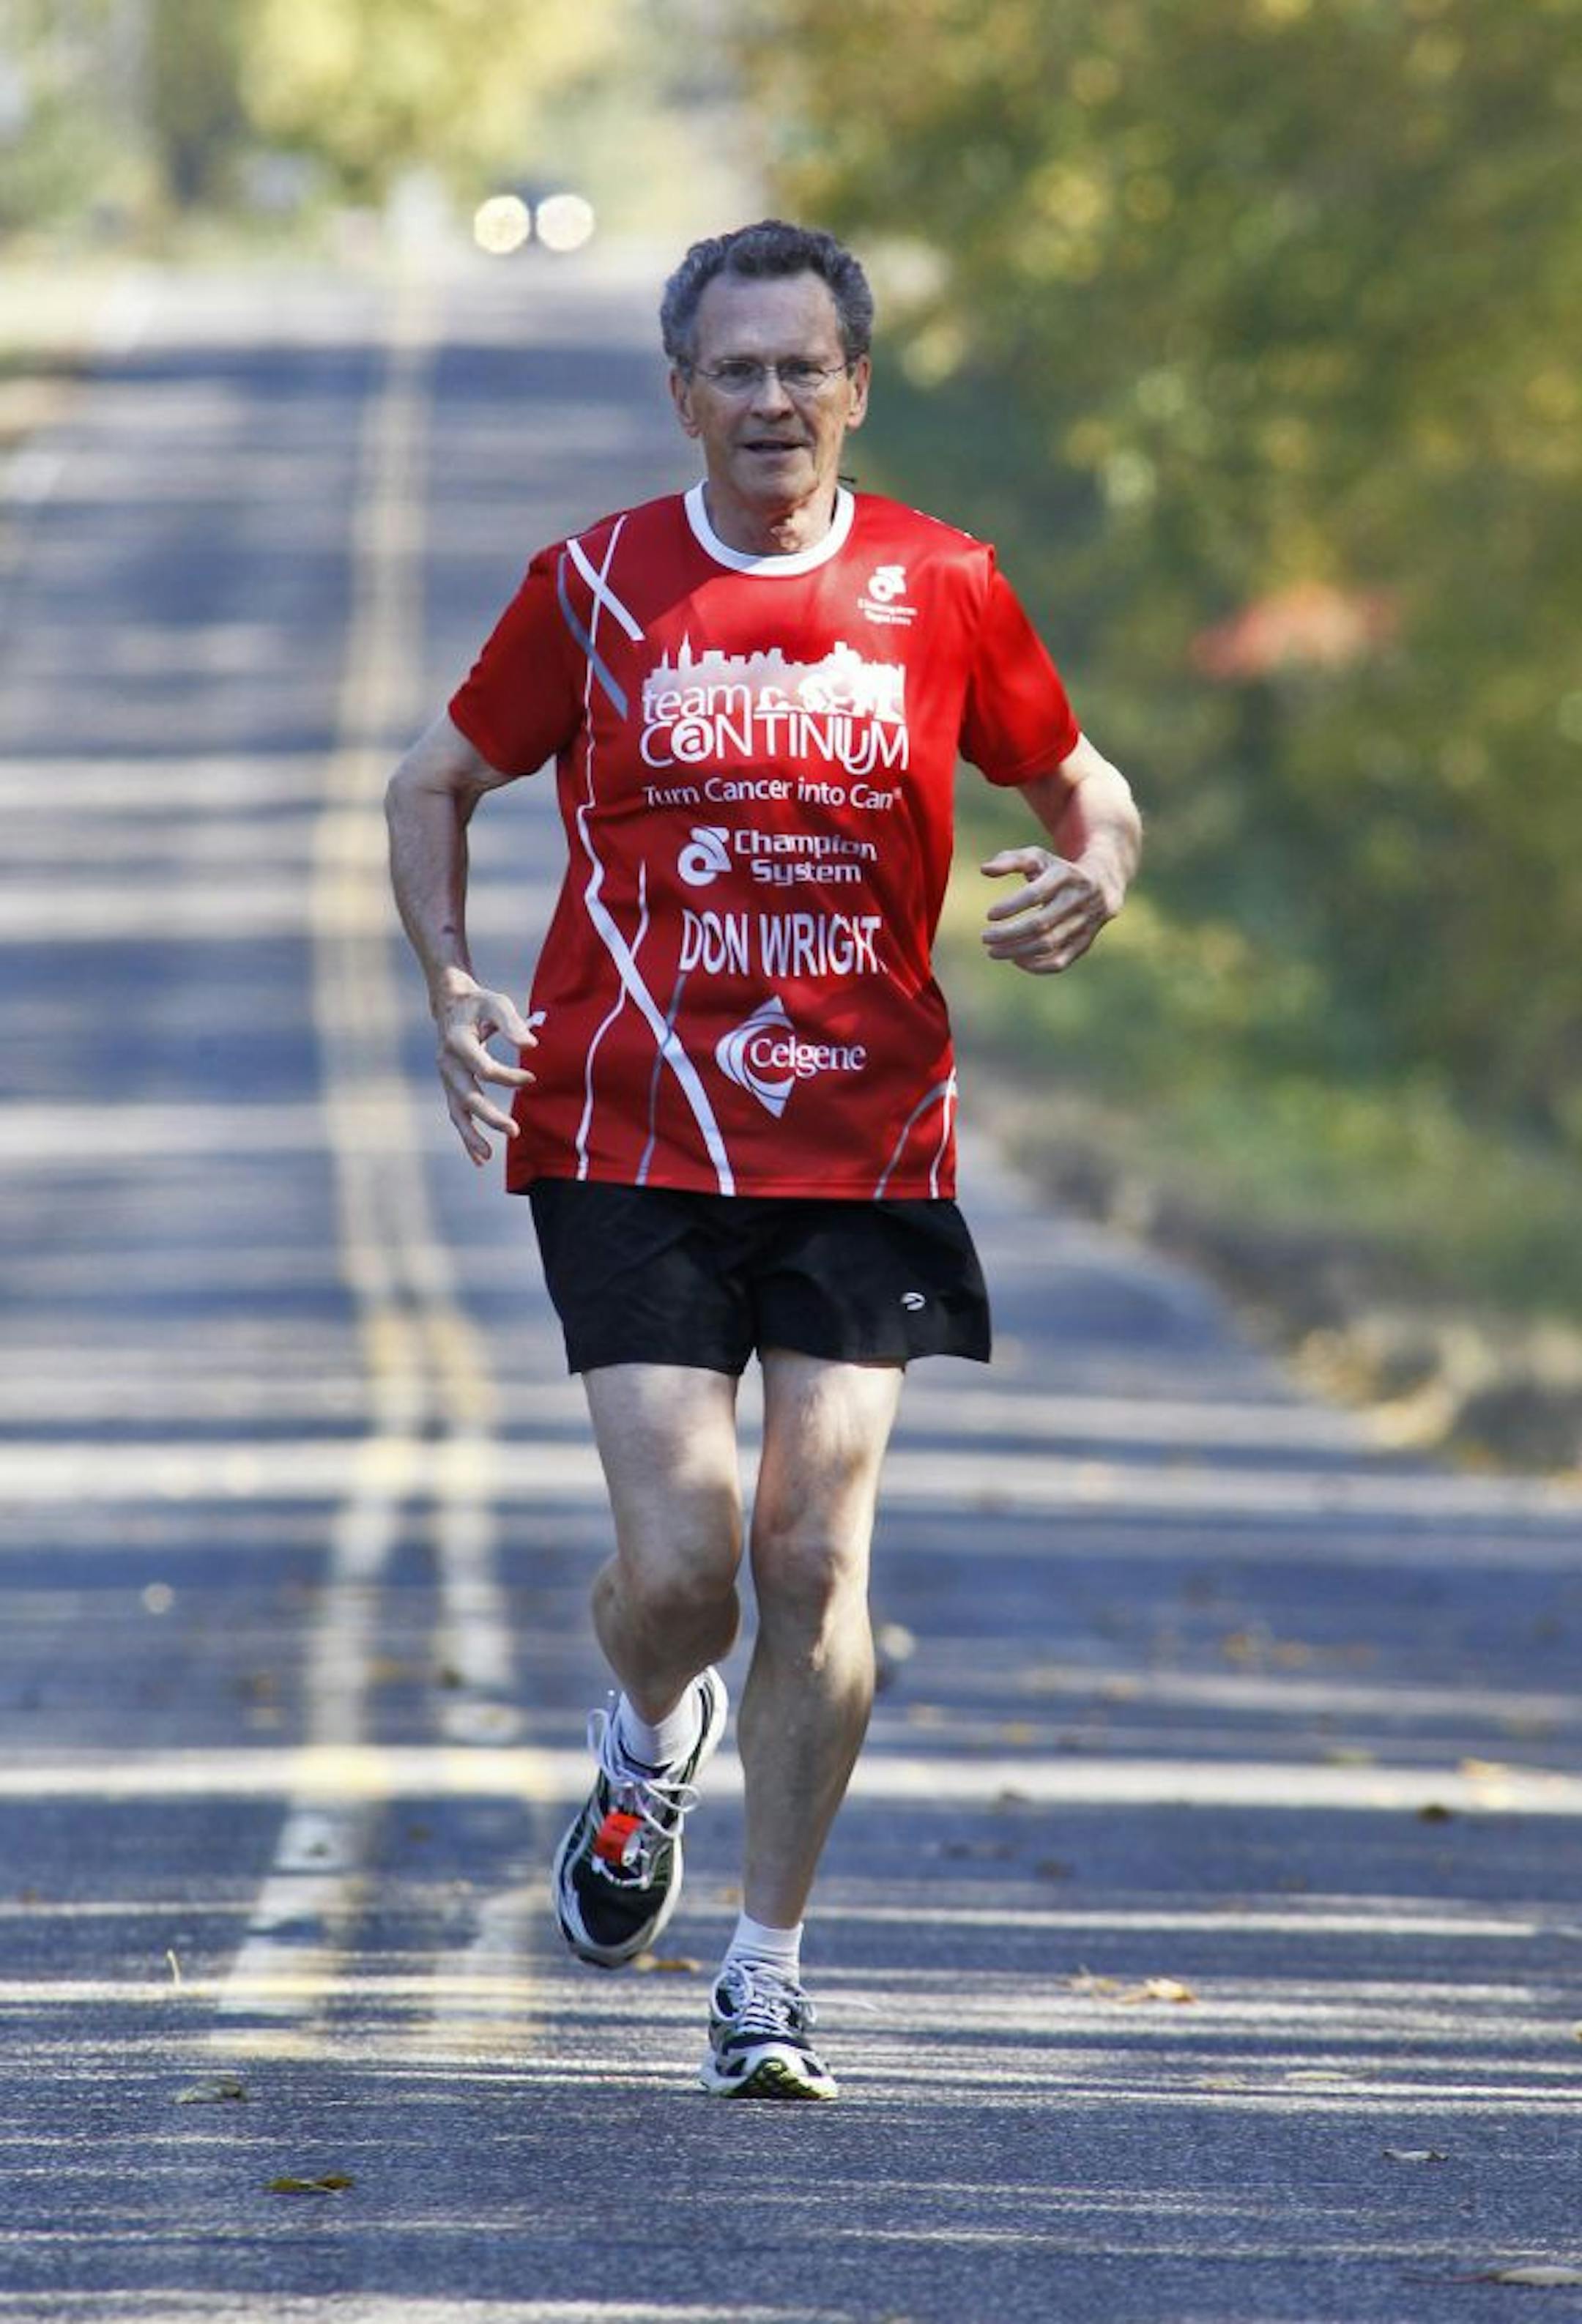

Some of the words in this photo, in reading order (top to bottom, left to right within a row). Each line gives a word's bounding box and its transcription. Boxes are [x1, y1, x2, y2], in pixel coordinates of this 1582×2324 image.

[643, 684, 751, 723] team
[642, 784, 700, 806] Turn
[705, 776, 792, 802] Cancer
[798, 776, 845, 806] into
[734, 829, 877, 861] Champion
[751, 858, 862, 886] System
[679, 908, 750, 975] DON
[750, 1035, 867, 1079] Celgene
